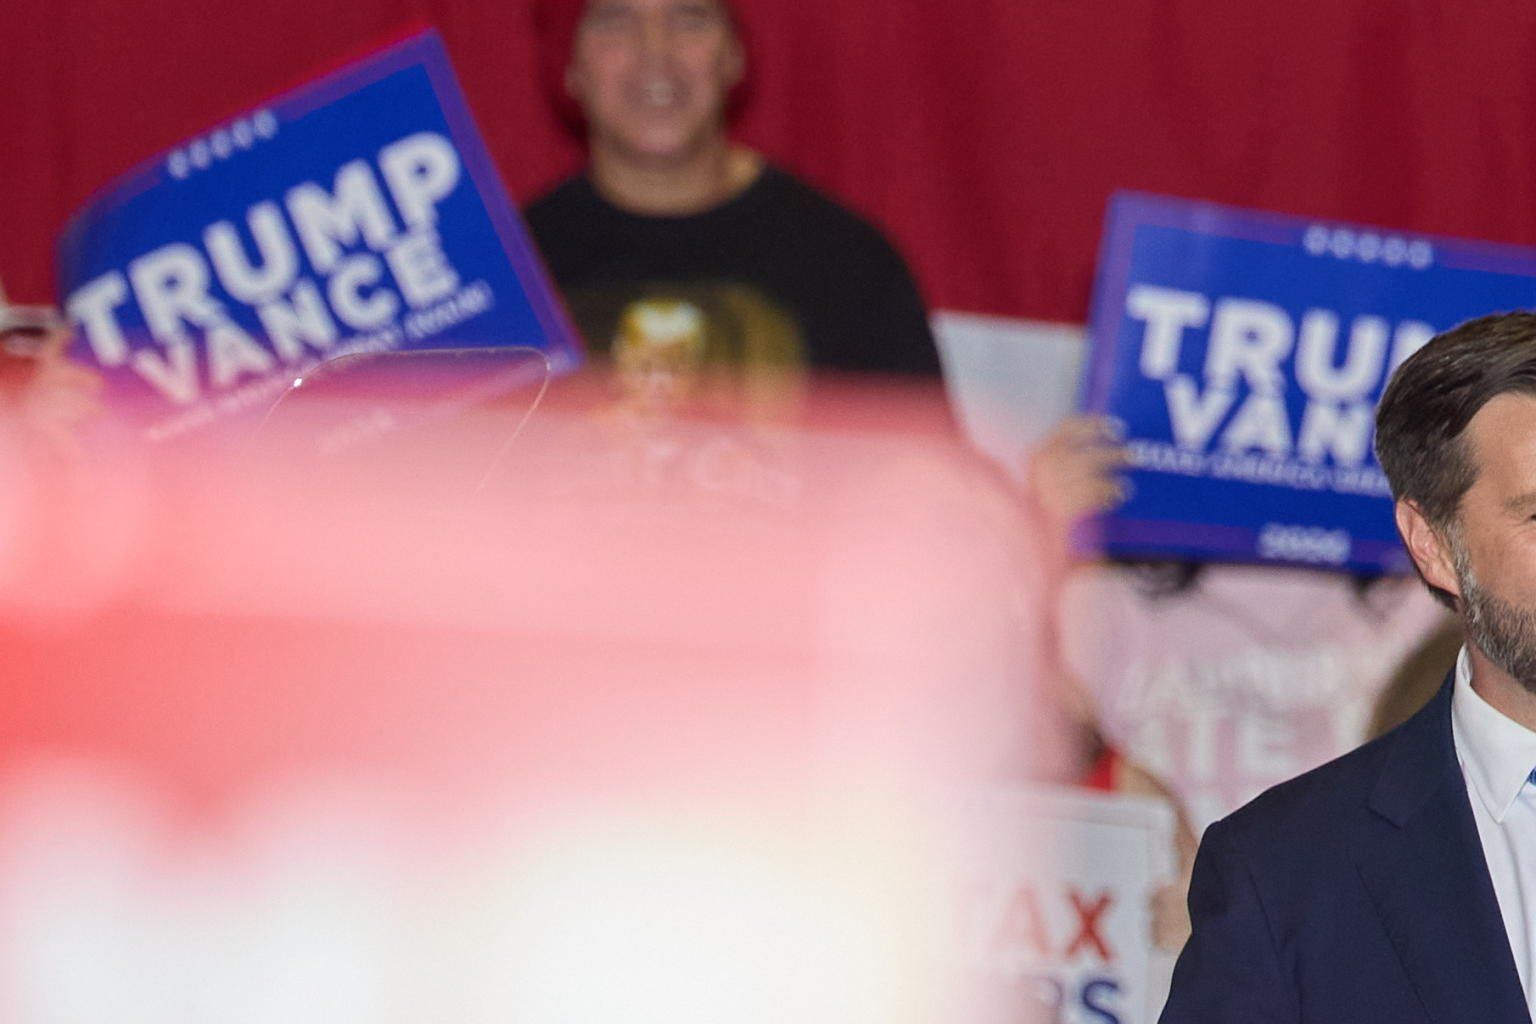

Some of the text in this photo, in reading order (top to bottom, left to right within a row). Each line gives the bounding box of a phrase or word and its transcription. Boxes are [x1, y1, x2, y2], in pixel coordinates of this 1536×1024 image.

[66, 131, 461, 367] TRUMP
[135, 228, 461, 403] VANCE
[1125, 283, 1437, 402] TRU
[1163, 373, 1378, 468] VAN
